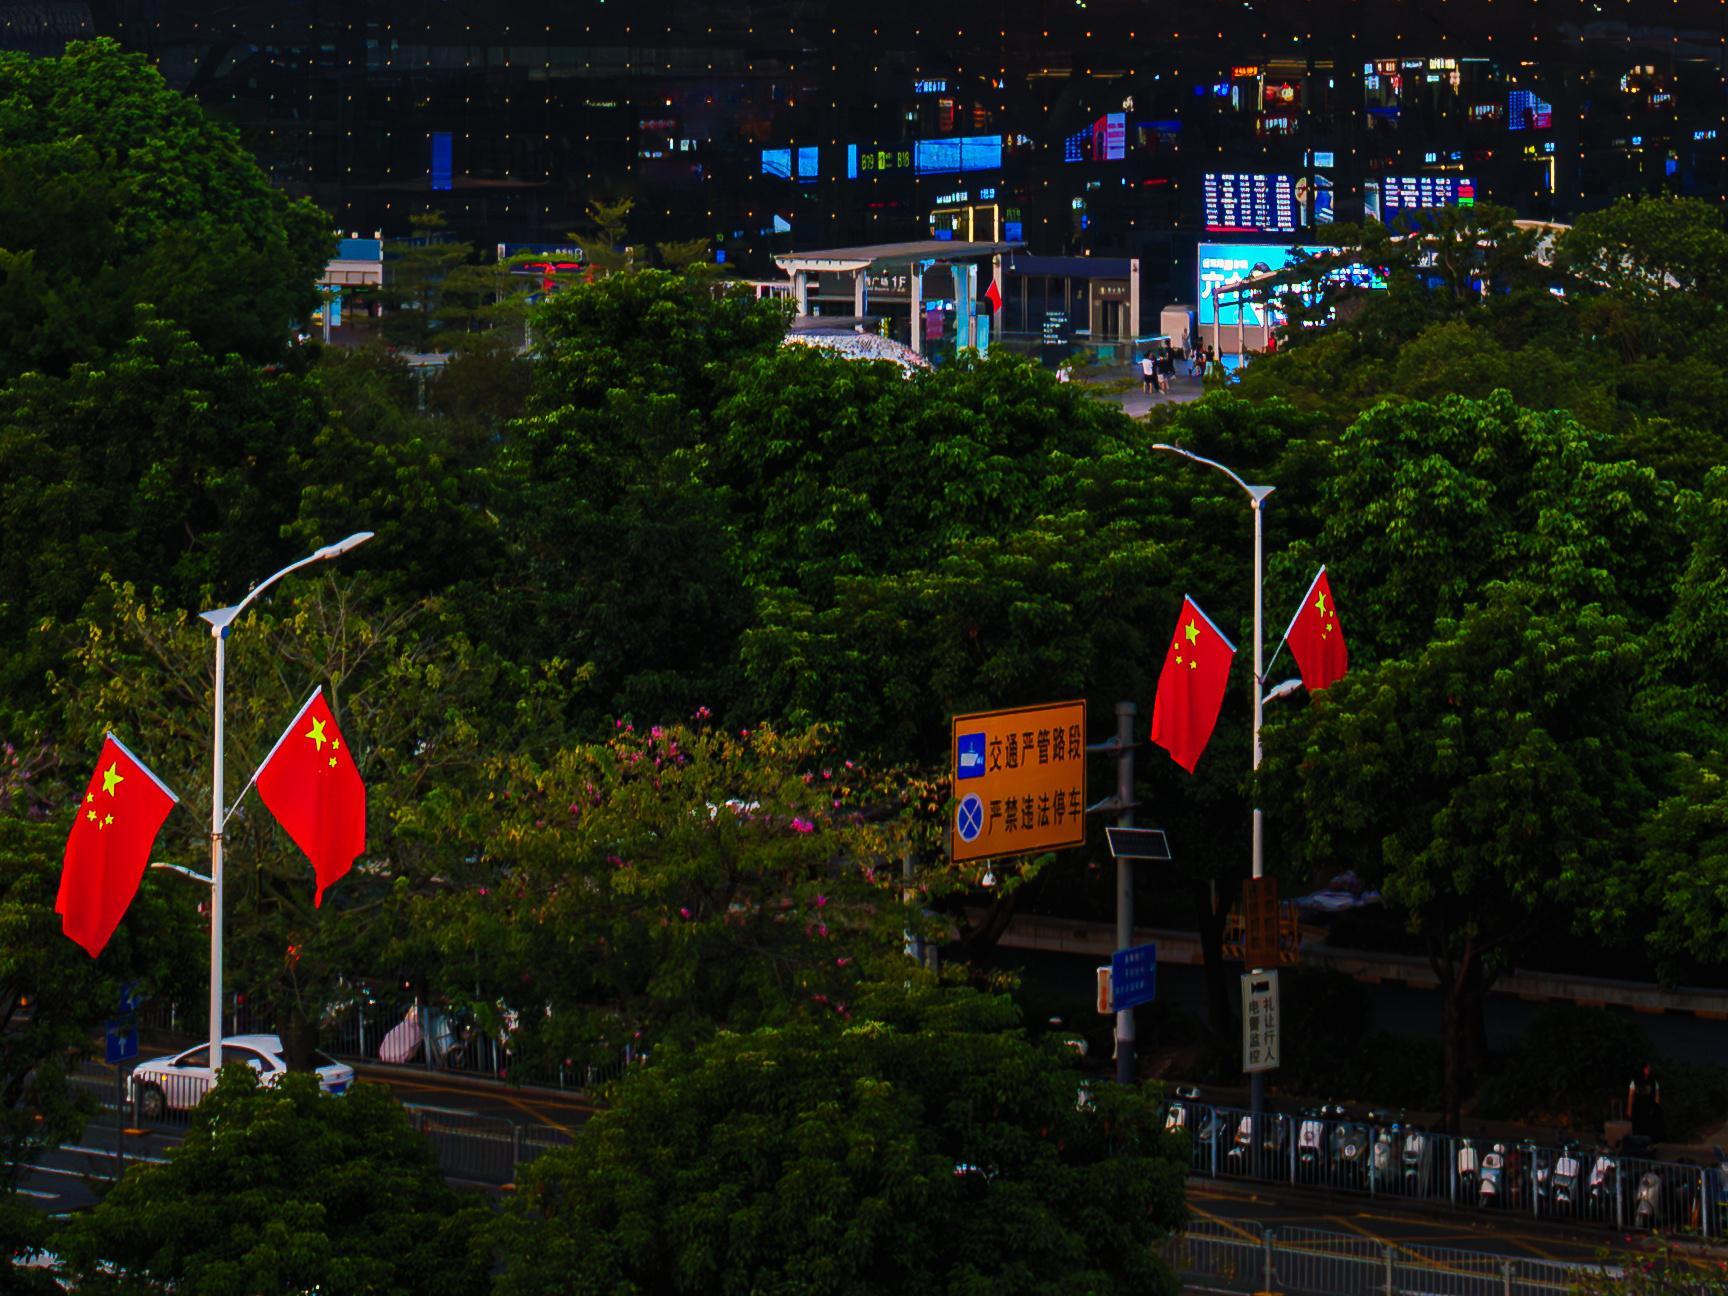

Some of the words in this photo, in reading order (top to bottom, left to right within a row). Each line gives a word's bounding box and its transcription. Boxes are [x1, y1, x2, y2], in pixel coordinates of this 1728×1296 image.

[989, 724, 1083, 774] 交通严管路段
[989, 786, 1083, 836] 严禁违法停车
[1262, 997, 1275, 1063] 礼让行人
